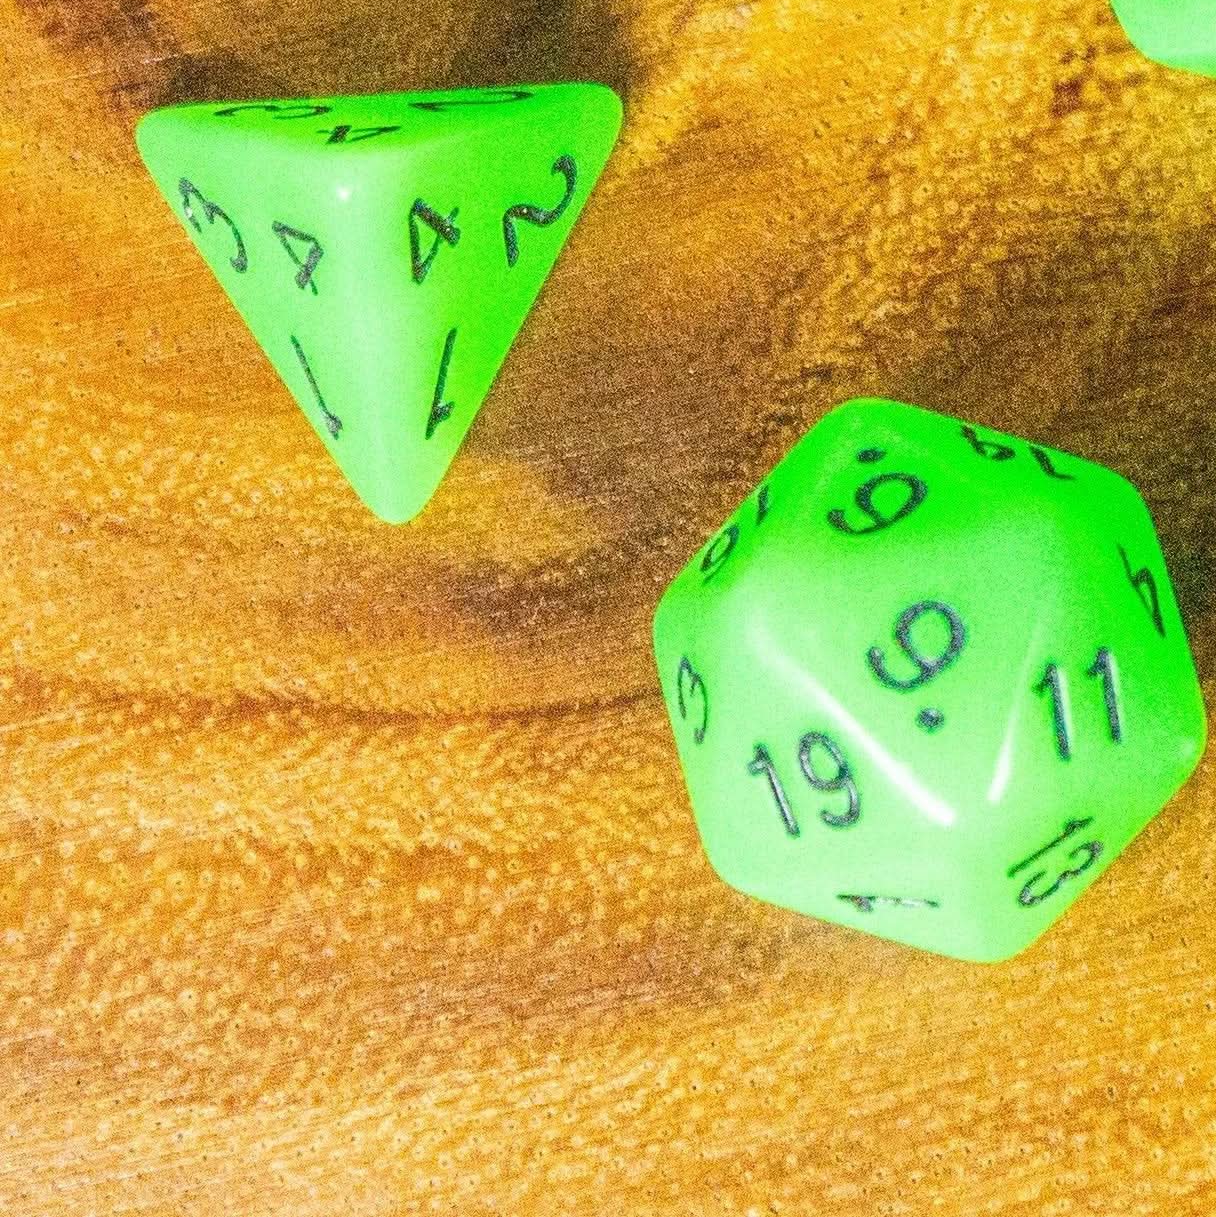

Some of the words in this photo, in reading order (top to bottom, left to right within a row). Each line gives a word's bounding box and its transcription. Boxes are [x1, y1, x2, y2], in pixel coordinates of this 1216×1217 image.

[178, 177, 248, 275] 3
[272, 221, 324, 295] 4
[408, 198, 461, 285] 4
[502, 154, 578, 269] 2
[425, 327, 458, 440] 1
[675, 655, 710, 746] 3
[1031, 645, 1122, 762] 11
[747, 730, 862, 838] 19
[1007, 817, 1104, 908] 13
